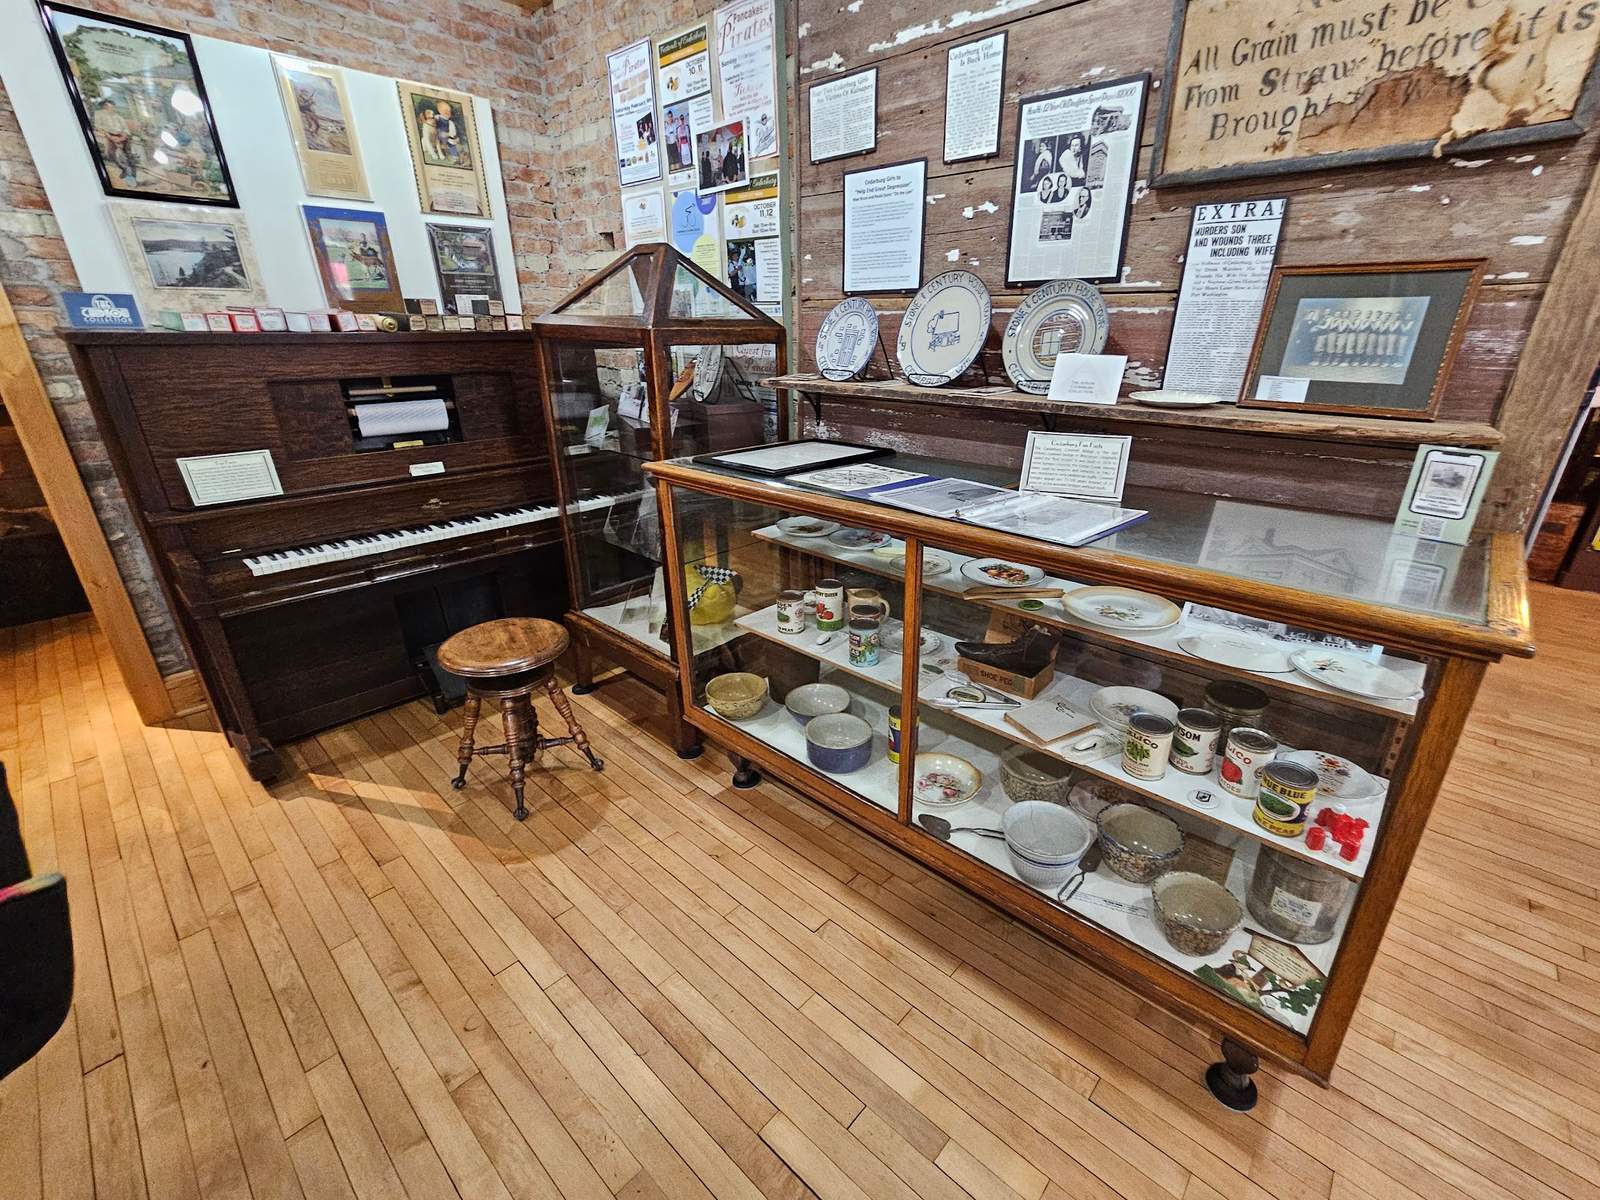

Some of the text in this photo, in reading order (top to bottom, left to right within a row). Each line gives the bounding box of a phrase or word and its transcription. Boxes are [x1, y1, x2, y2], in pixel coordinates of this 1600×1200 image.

[1184, 45, 1219, 76] All
[1231, 29, 1297, 66] Grain
[1310, 4, 1394, 50] must
[1183, 83, 1240, 111] From
[1377, 26, 1492, 75] before
[1553, 2, 1597, 36] is
[1207, 92, 1337, 142] Brought
[753, 201, 776, 210] OCTOBER
[1197, 200, 1283, 221] EXTRA!
[1195, 224, 1247, 236] MURDERS SON
[1194, 234, 1272, 248] AND WOUNDS THREE
[1210, 245, 1276, 258] INCLUDING WIFE
[905, 300, 923, 328] STONE
[927, 273, 965, 294] CENTURY
[1008, 308, 1026, 338] STONE
[1031, 281, 1074, 305] CENTURY
[980, 670, 999, 681] SHOE
[1280, 787, 1306, 799] BLUE
